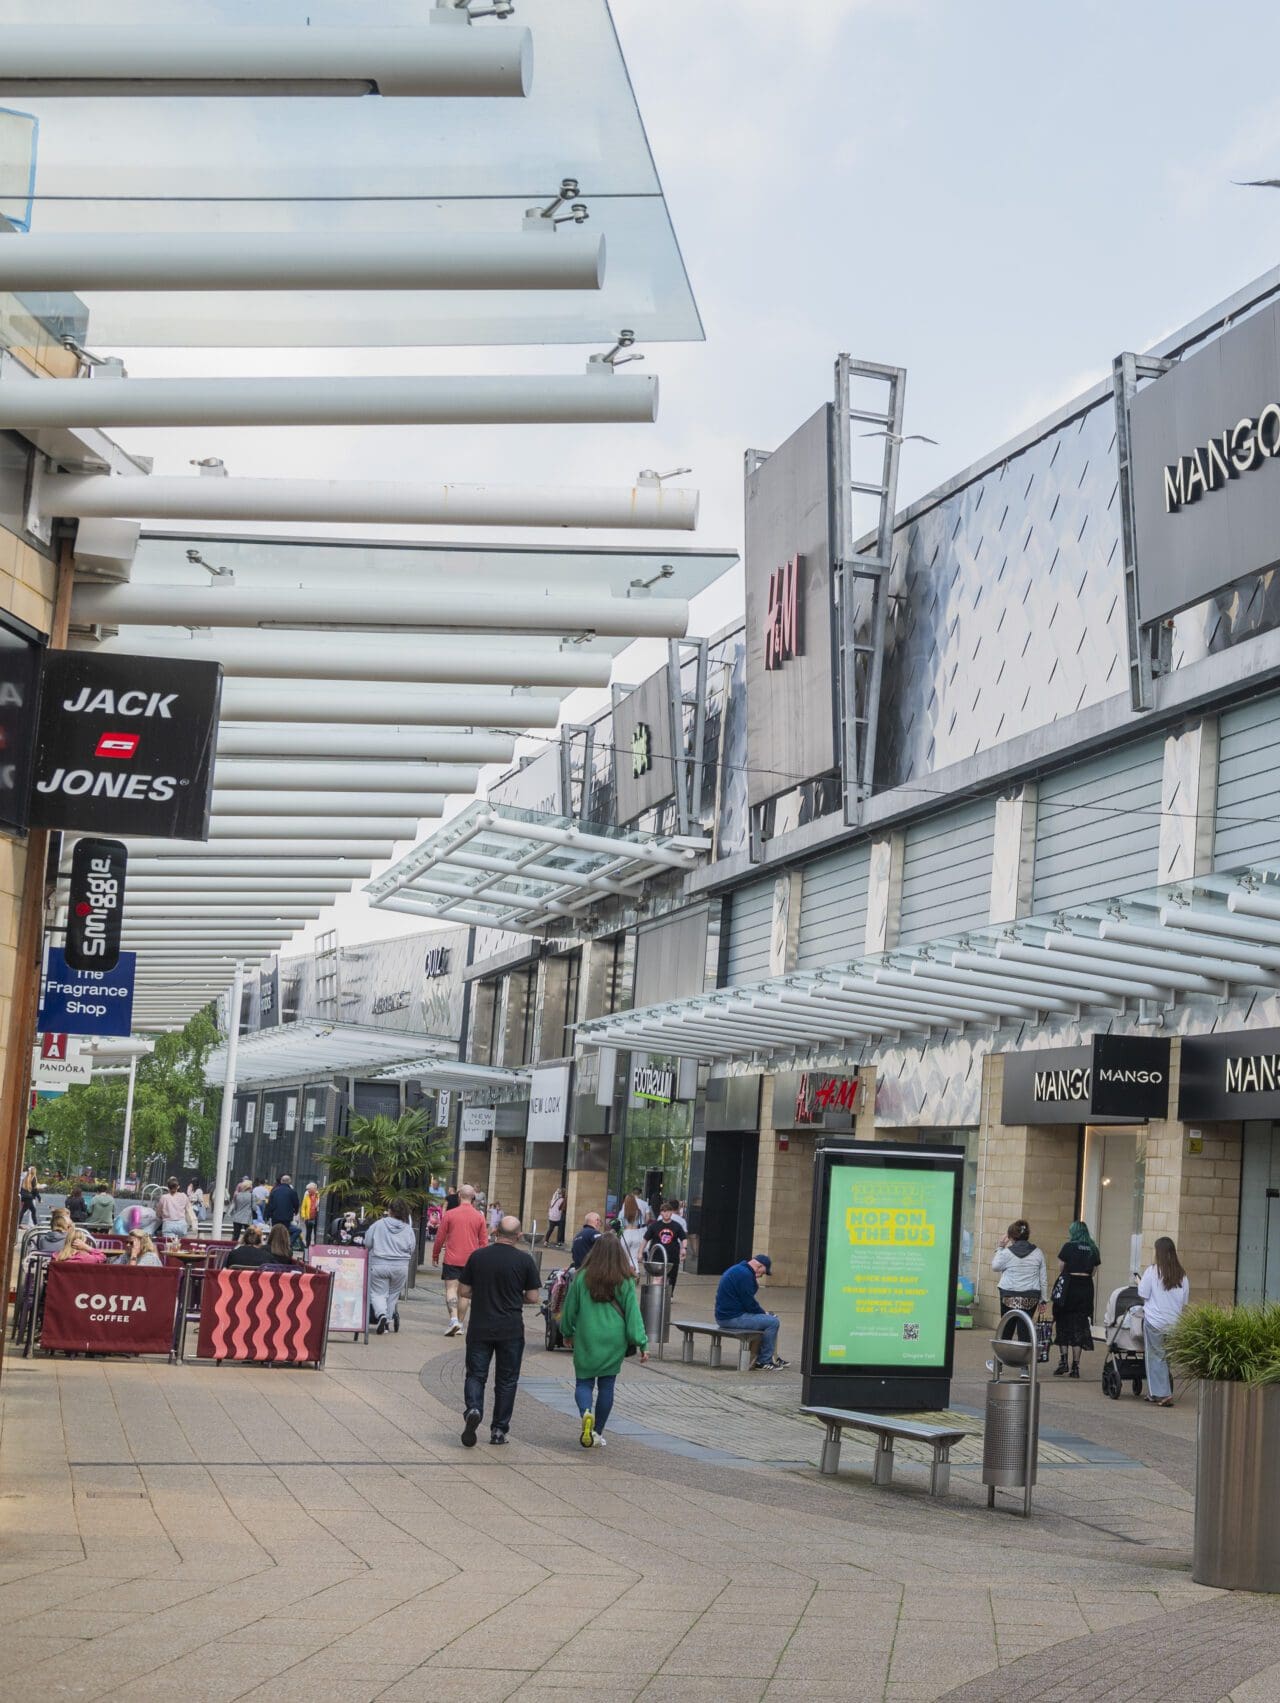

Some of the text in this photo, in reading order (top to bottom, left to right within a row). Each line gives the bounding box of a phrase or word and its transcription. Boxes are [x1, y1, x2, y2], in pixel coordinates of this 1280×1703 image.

[764, 552, 801, 671] H&M
[63, 687, 179, 719] JACK
[46, 981, 129, 998] Fragrance
[66, 1001, 107, 1017] Shop
[1100, 1069, 1162, 1084] MANGO
[816, 1077, 859, 1110] H&M
[531, 1095, 561, 1114] NEW LOOK
[471, 1112, 492, 1120] NEW
[850, 1211, 922, 1226] HOP ON
[853, 1227, 932, 1242] THE BUS
[327, 1248, 350, 1256] COSTA
[74, 1293, 148, 1313] COSTA
[89, 1313, 130, 1323] COFFEE
